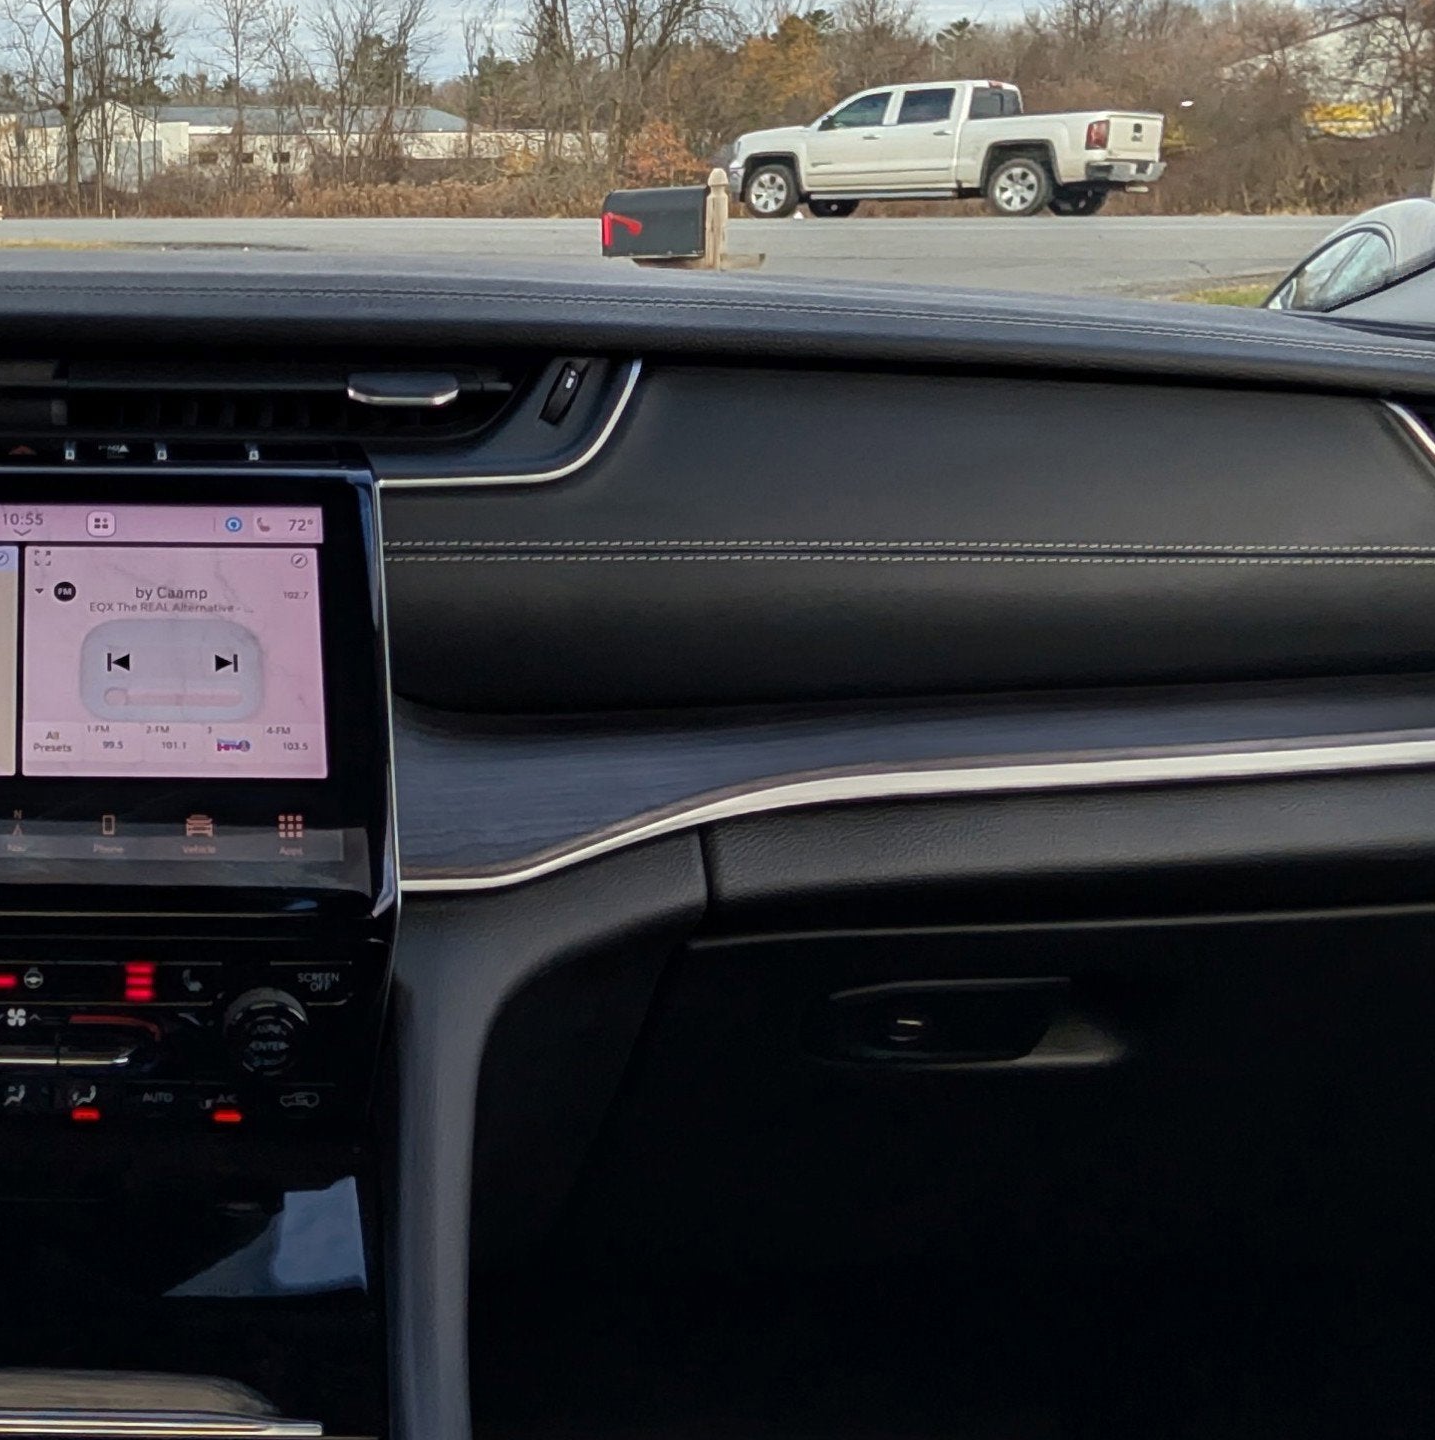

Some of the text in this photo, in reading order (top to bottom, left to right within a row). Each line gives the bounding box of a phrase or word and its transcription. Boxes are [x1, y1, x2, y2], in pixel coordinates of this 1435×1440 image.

[2, 512, 45, 527] 10:55
[288, 518, 314, 533] 72°
[135, 585, 209, 602] by Caamp
[89, 602, 234, 614] EQX The REAL Alternative
[45, 730, 60, 741] All
[33, 742, 73, 753] Presets
[182, 844, 217, 855] Vehicle
[142, 1091, 174, 1103] AUTO
